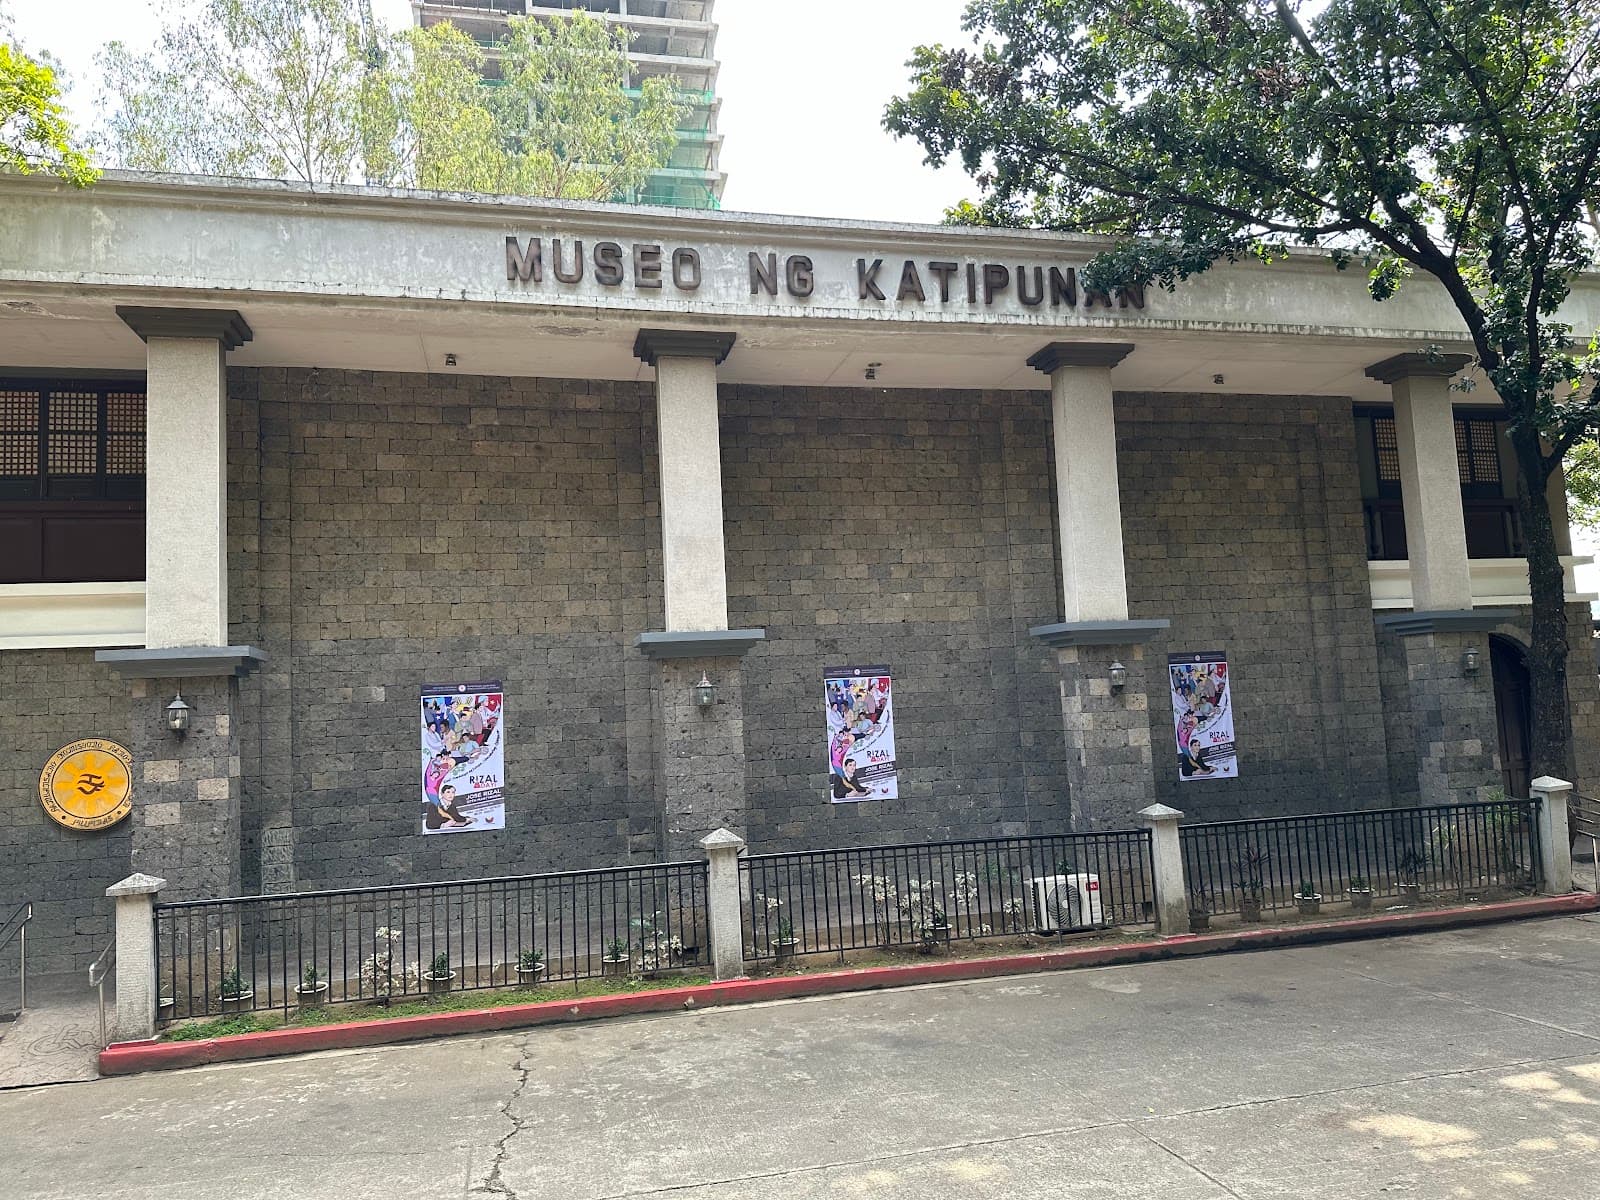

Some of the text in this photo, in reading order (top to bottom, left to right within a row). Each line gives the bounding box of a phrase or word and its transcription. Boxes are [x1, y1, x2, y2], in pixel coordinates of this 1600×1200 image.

[505, 236, 702, 291] MUSEO
[749, 251, 814, 298] NG
[1209, 730, 1230, 739] RIZAL
[866, 749, 890, 759] RIZAL
[469, 774, 498, 784] RIZAL
[483, 788, 502, 797] RIZAL
